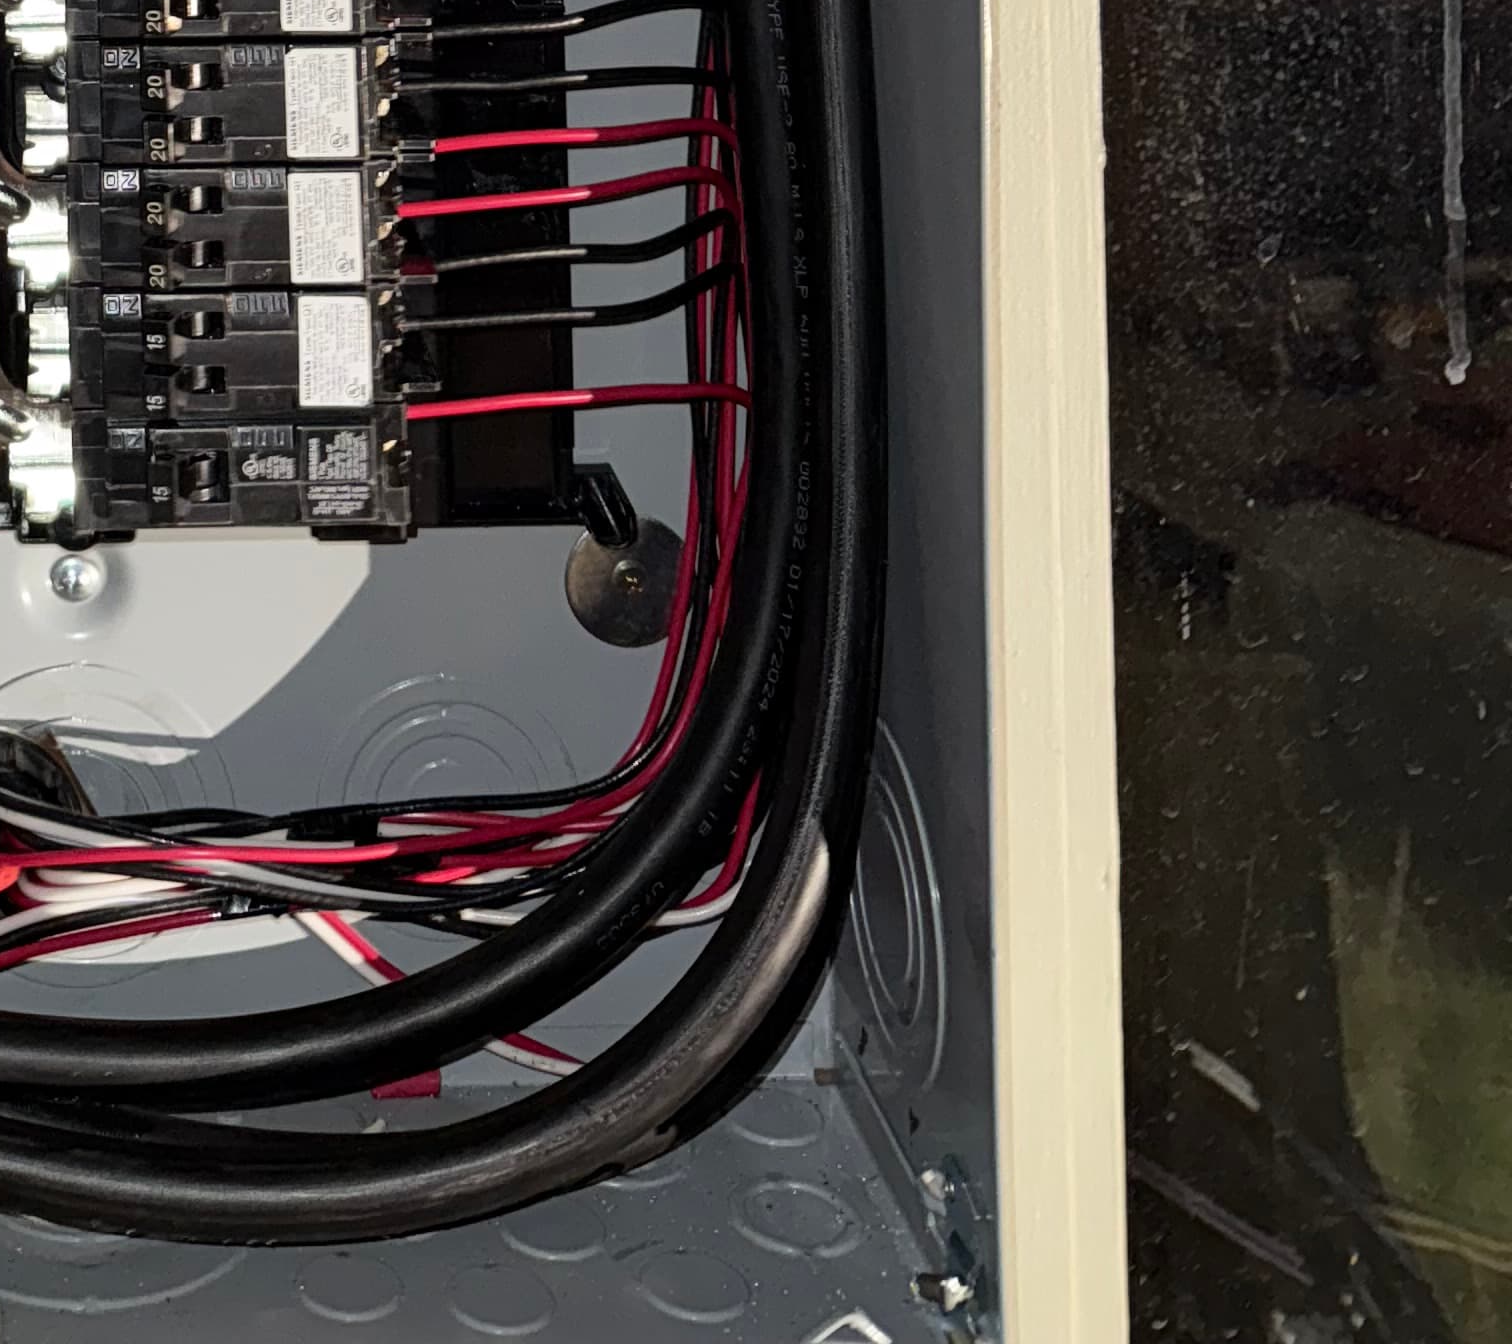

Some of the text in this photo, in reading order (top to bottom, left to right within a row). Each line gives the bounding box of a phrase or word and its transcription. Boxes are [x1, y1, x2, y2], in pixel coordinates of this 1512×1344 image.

[146, 10, 162, 32] 20
[147, 76, 164, 99] 20
[150, 138, 166, 162] 20
[146, 202, 162, 225] 20
[149, 264, 166, 289] 20
[792, 254, 810, 300] XLP
[146, 334, 166, 350] 15
[146, 394, 166, 412] 15
[152, 486, 170, 502] 15
